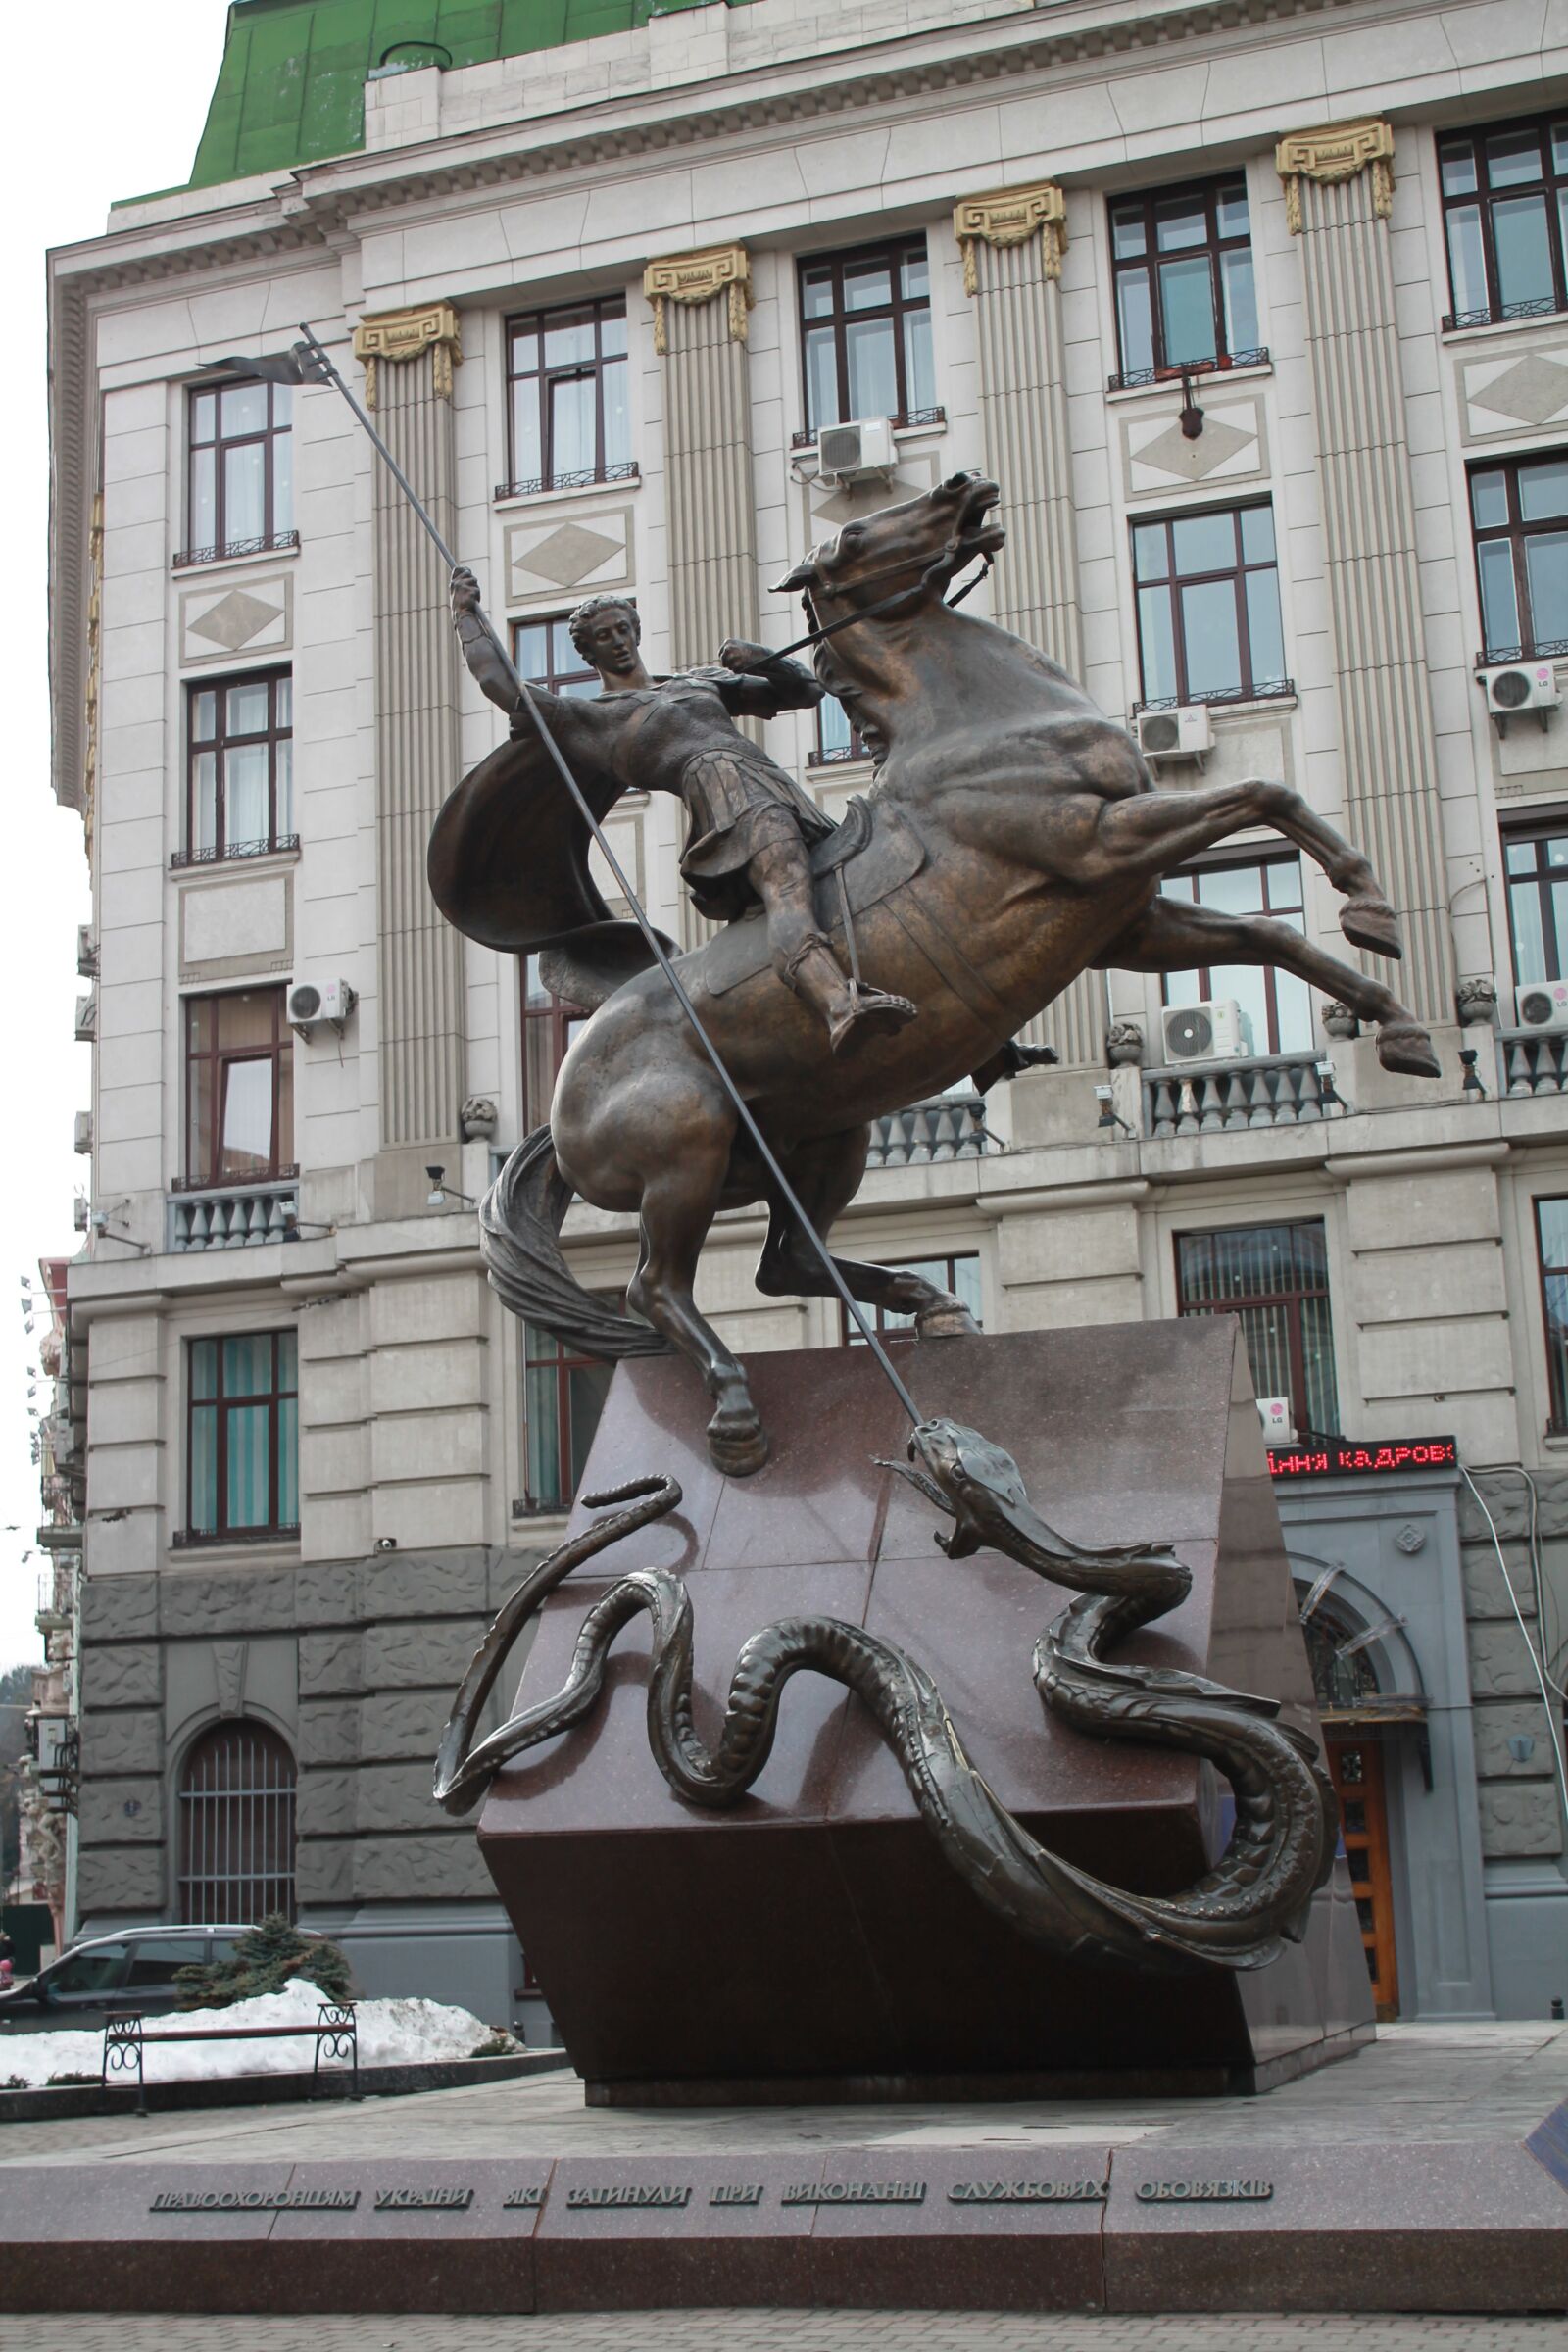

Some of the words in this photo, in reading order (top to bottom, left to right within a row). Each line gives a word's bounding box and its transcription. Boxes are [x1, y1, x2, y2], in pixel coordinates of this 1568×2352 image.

[1556, 1000, 1568, 1008] LG
[150, 2189, 361, 2212] ПРАВООХОРОНЦЯМ
[503, 2186, 547, 2208] ЯКІ
[566, 2185, 692, 2208] ЗАГИНУЛИ
[710, 2184, 764, 2205] ПРИ
[782, 2180, 927, 2205] ВИКОНАННІ
[948, 2180, 1109, 2202] СЛУЖБОВИХ
